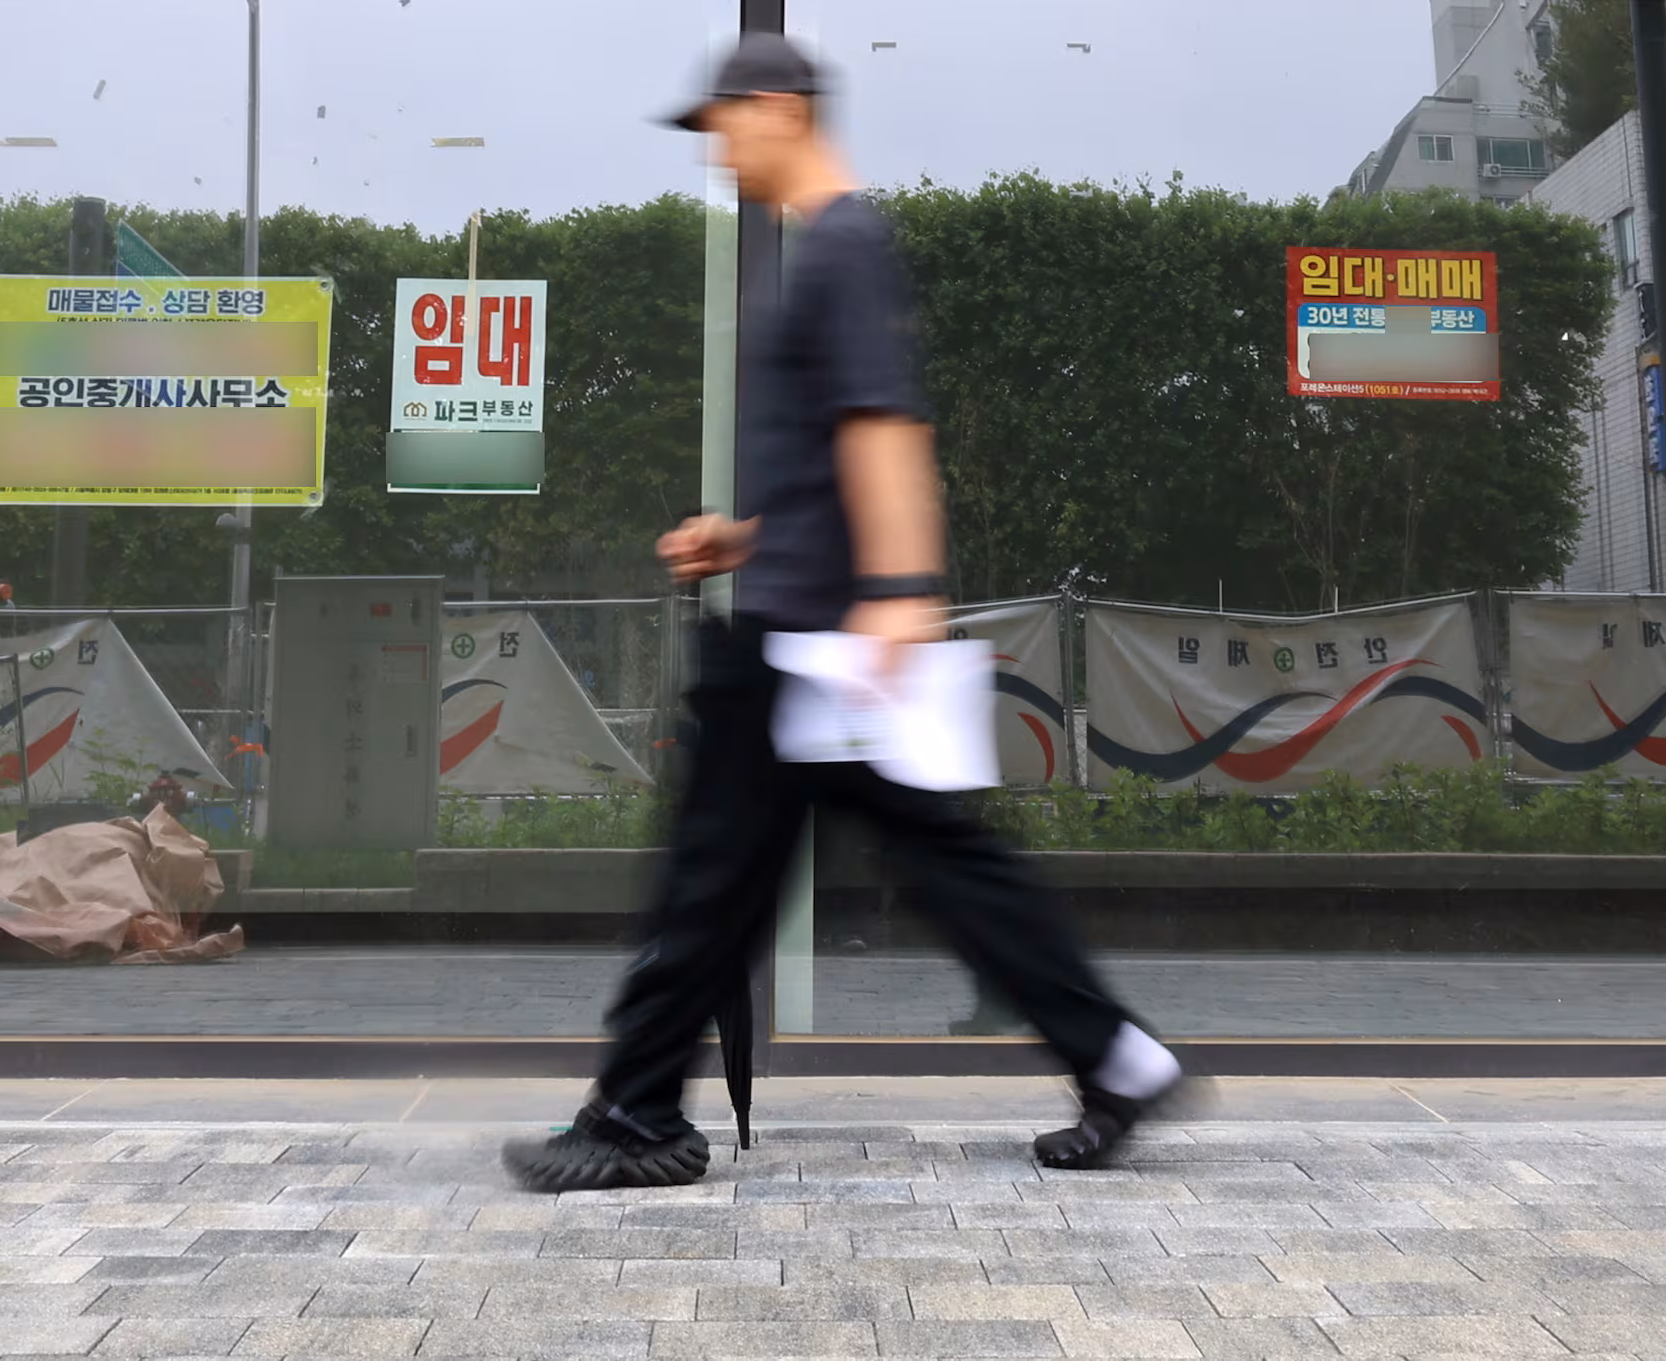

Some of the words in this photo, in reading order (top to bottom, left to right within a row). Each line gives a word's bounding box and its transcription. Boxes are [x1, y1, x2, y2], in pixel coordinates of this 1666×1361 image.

[47, 288, 142, 314] 매물접수
[162, 288, 210, 314] 상담
[216, 289, 265, 315] 환영
[1308, 307, 1348, 326] 30년
[1353, 307, 1385, 327] 전통
[411, 293, 532, 387] 임대
[19, 377, 288, 408] 공인중개사사무소
